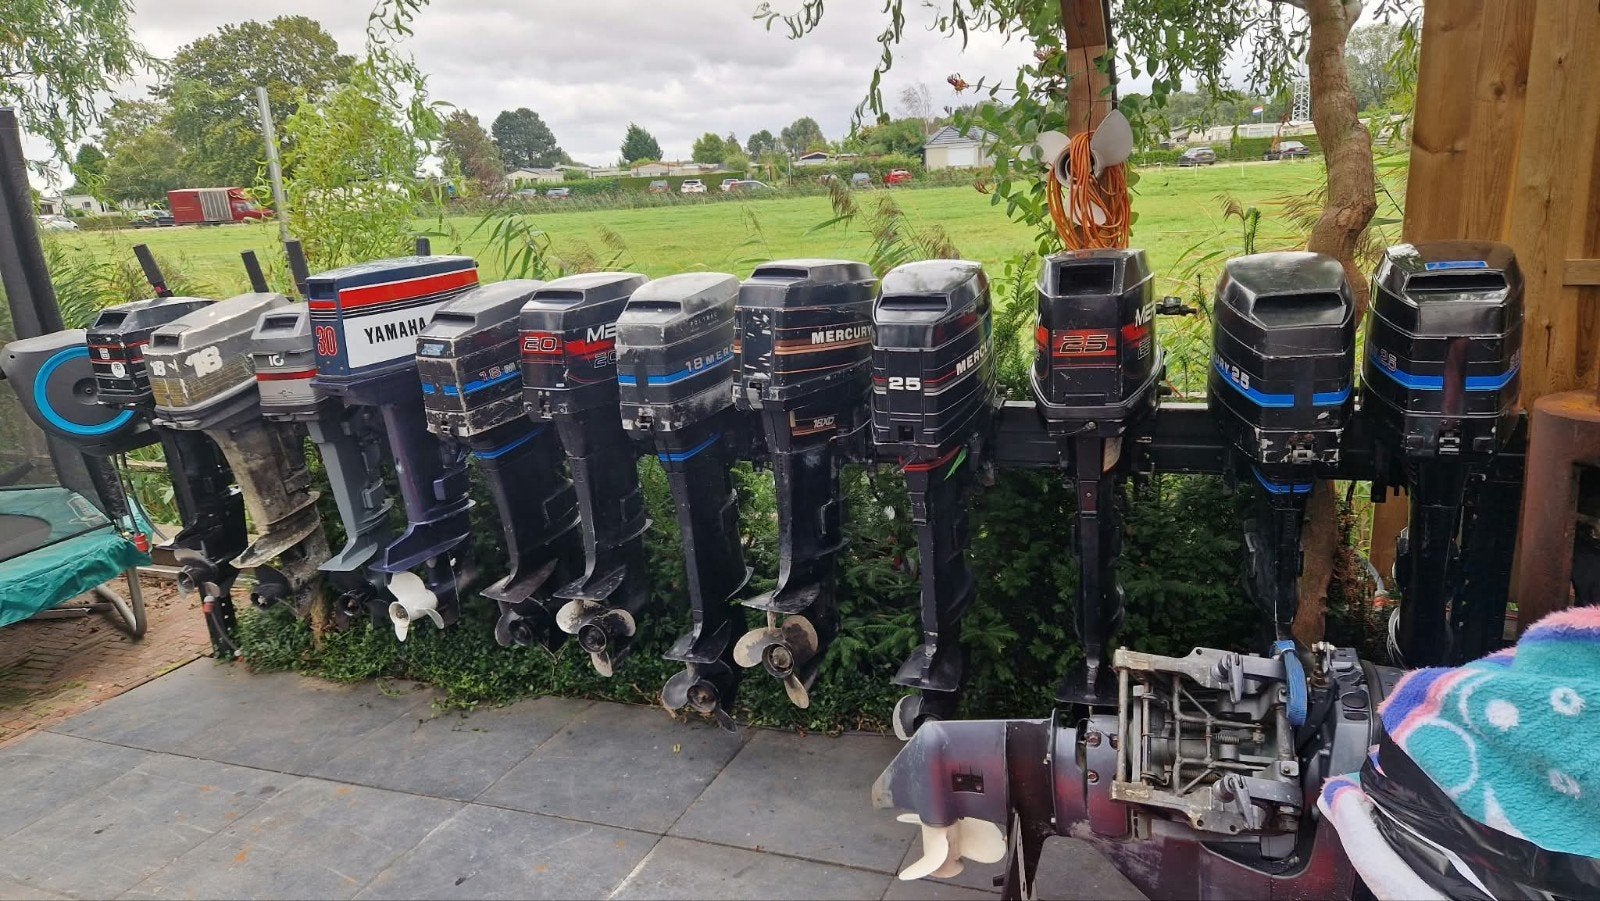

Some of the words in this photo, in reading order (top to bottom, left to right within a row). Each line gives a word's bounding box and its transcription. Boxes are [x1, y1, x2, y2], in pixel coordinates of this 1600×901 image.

[364, 316, 427, 344] YAMAHA
[811, 325, 873, 344] MERCURY
[316, 326, 338, 356] 30
[523, 337, 557, 352] 20
[1060, 335, 1108, 354] 25
[183, 346, 223, 378] 18
[685, 357, 703, 372] 18
[888, 377, 922, 391] 25
[1231, 366, 1250, 390] 25
